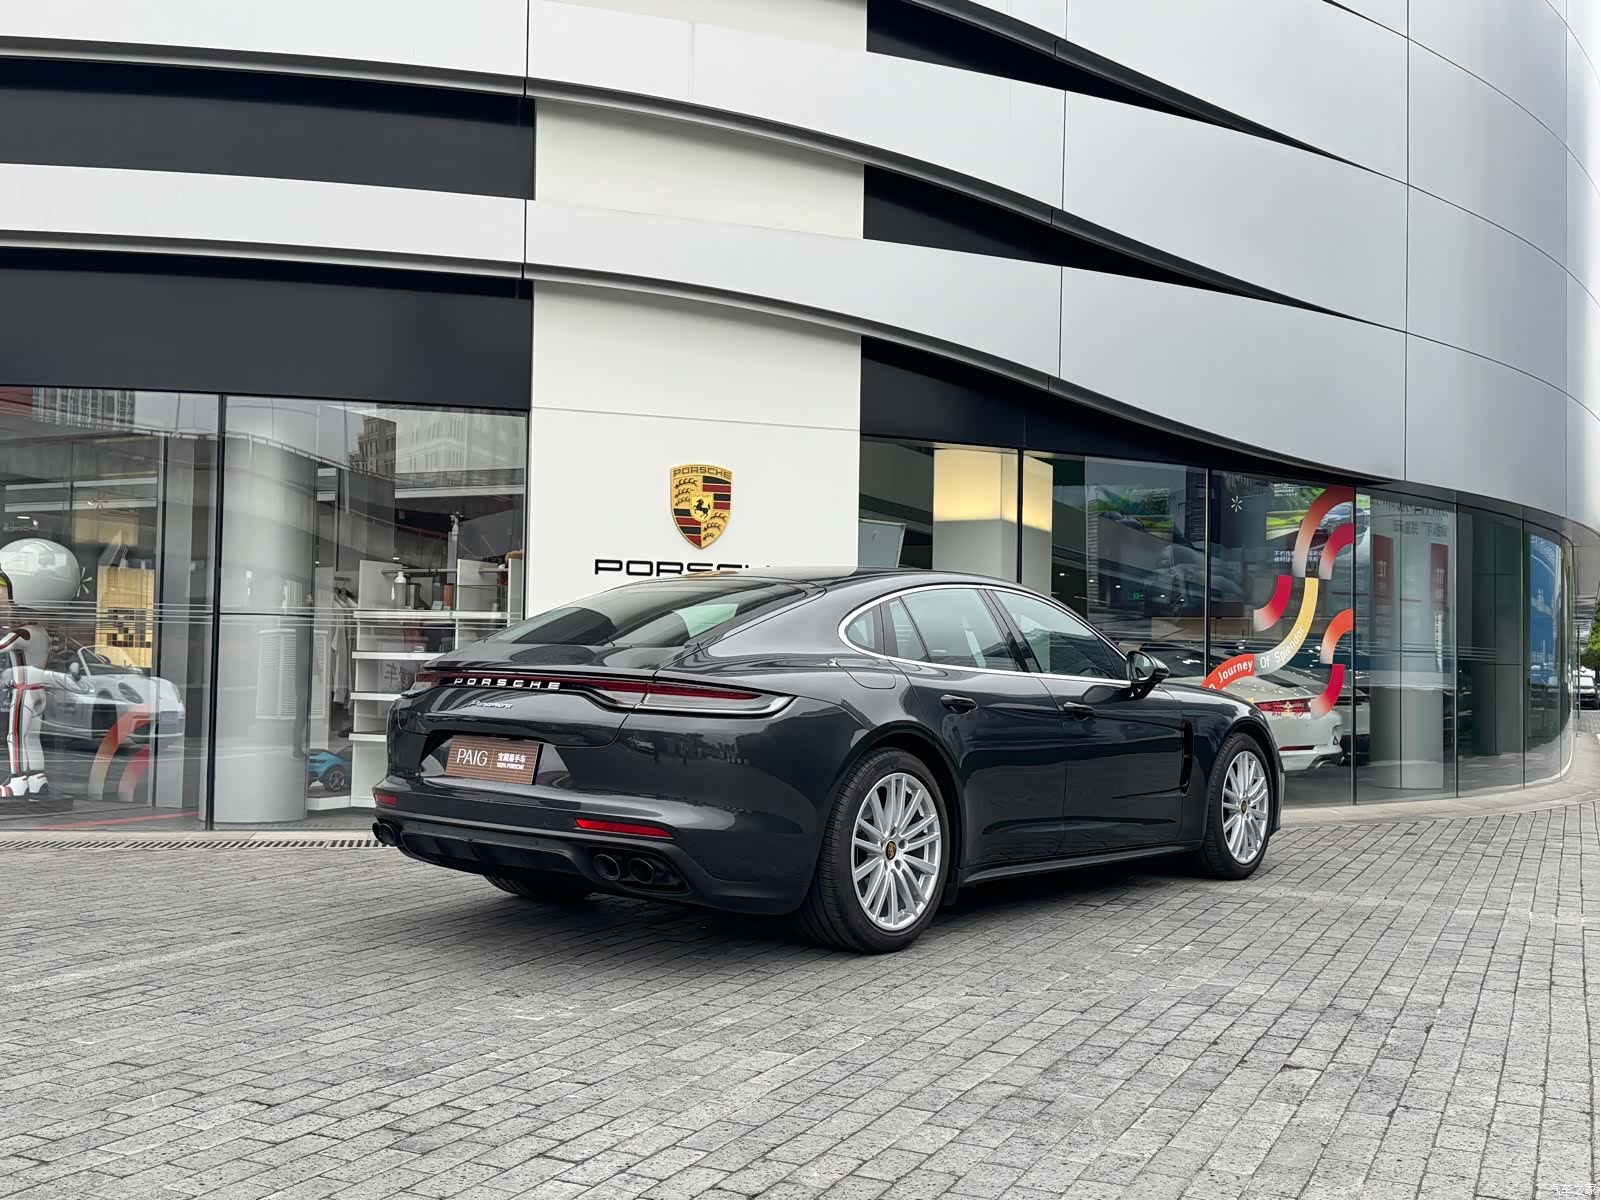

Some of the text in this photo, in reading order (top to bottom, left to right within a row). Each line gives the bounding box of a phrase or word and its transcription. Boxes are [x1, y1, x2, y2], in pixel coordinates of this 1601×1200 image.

[673, 466, 732, 479] PORSCHE
[595, 558, 770, 577] PORS
[1218, 660, 1253, 683] Journey
[1274, 626, 1304, 662] Splendor
[453, 678, 561, 691] PORSCHE
[456, 748, 489, 767] PAIG
